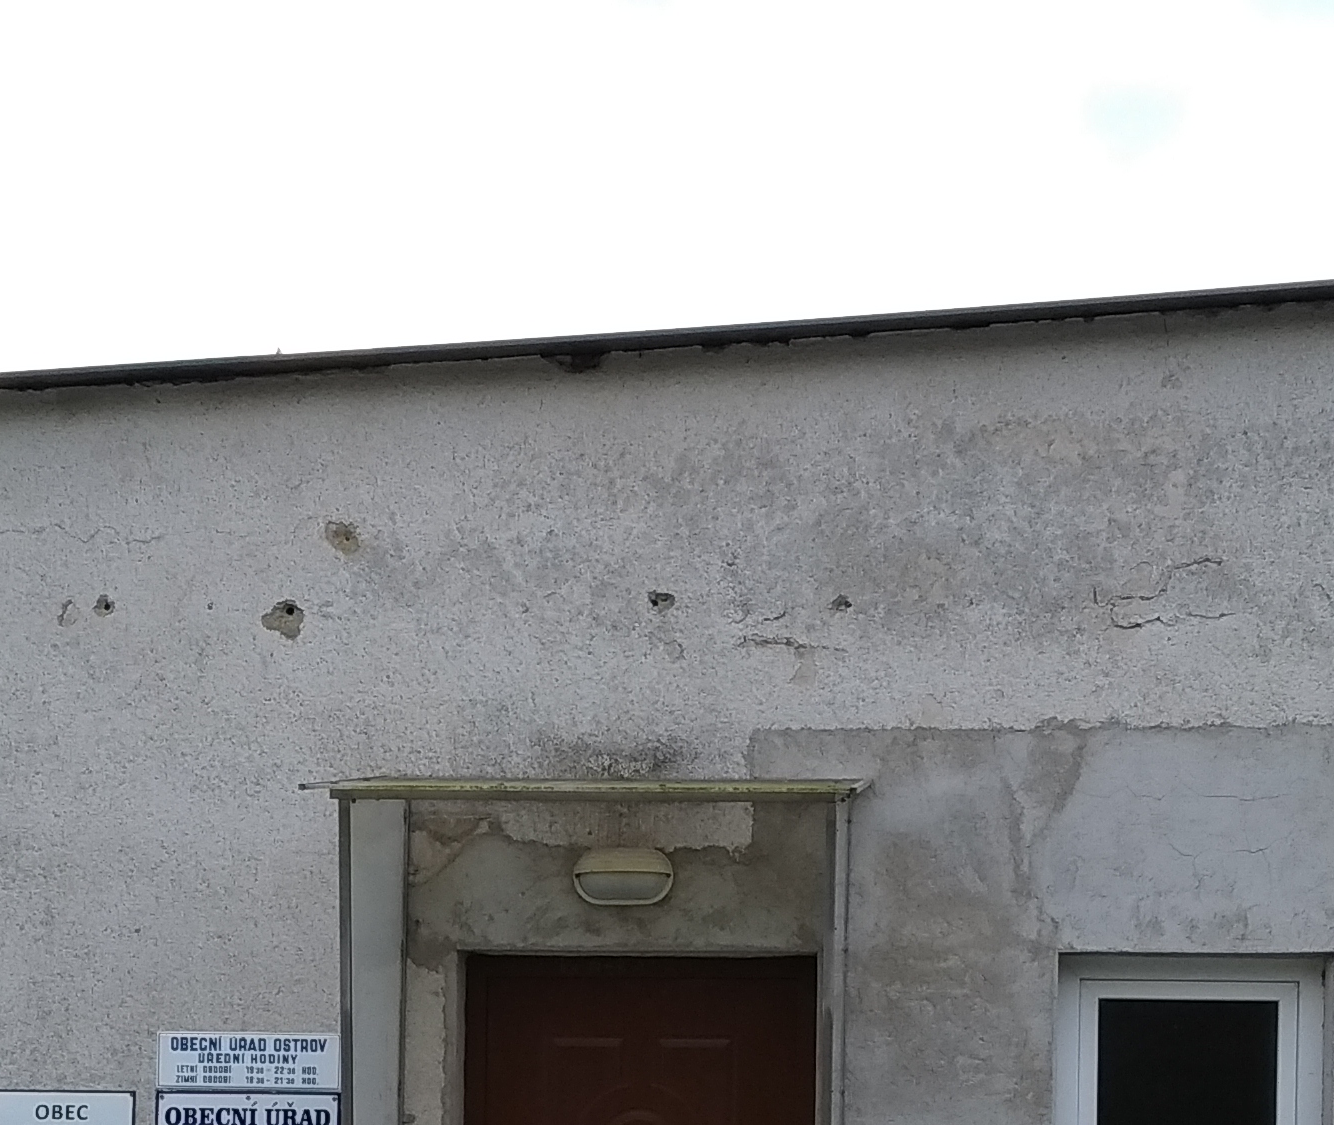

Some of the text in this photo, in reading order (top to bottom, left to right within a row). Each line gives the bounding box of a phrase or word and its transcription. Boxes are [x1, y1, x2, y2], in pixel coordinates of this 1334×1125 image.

[170, 1036, 328, 1053] OBECNÍ ÚŘAD OSTROV
[197, 1052, 299, 1065] ÚŘEDNÍ HODINY
[34, 1103, 90, 1121] OBEC
